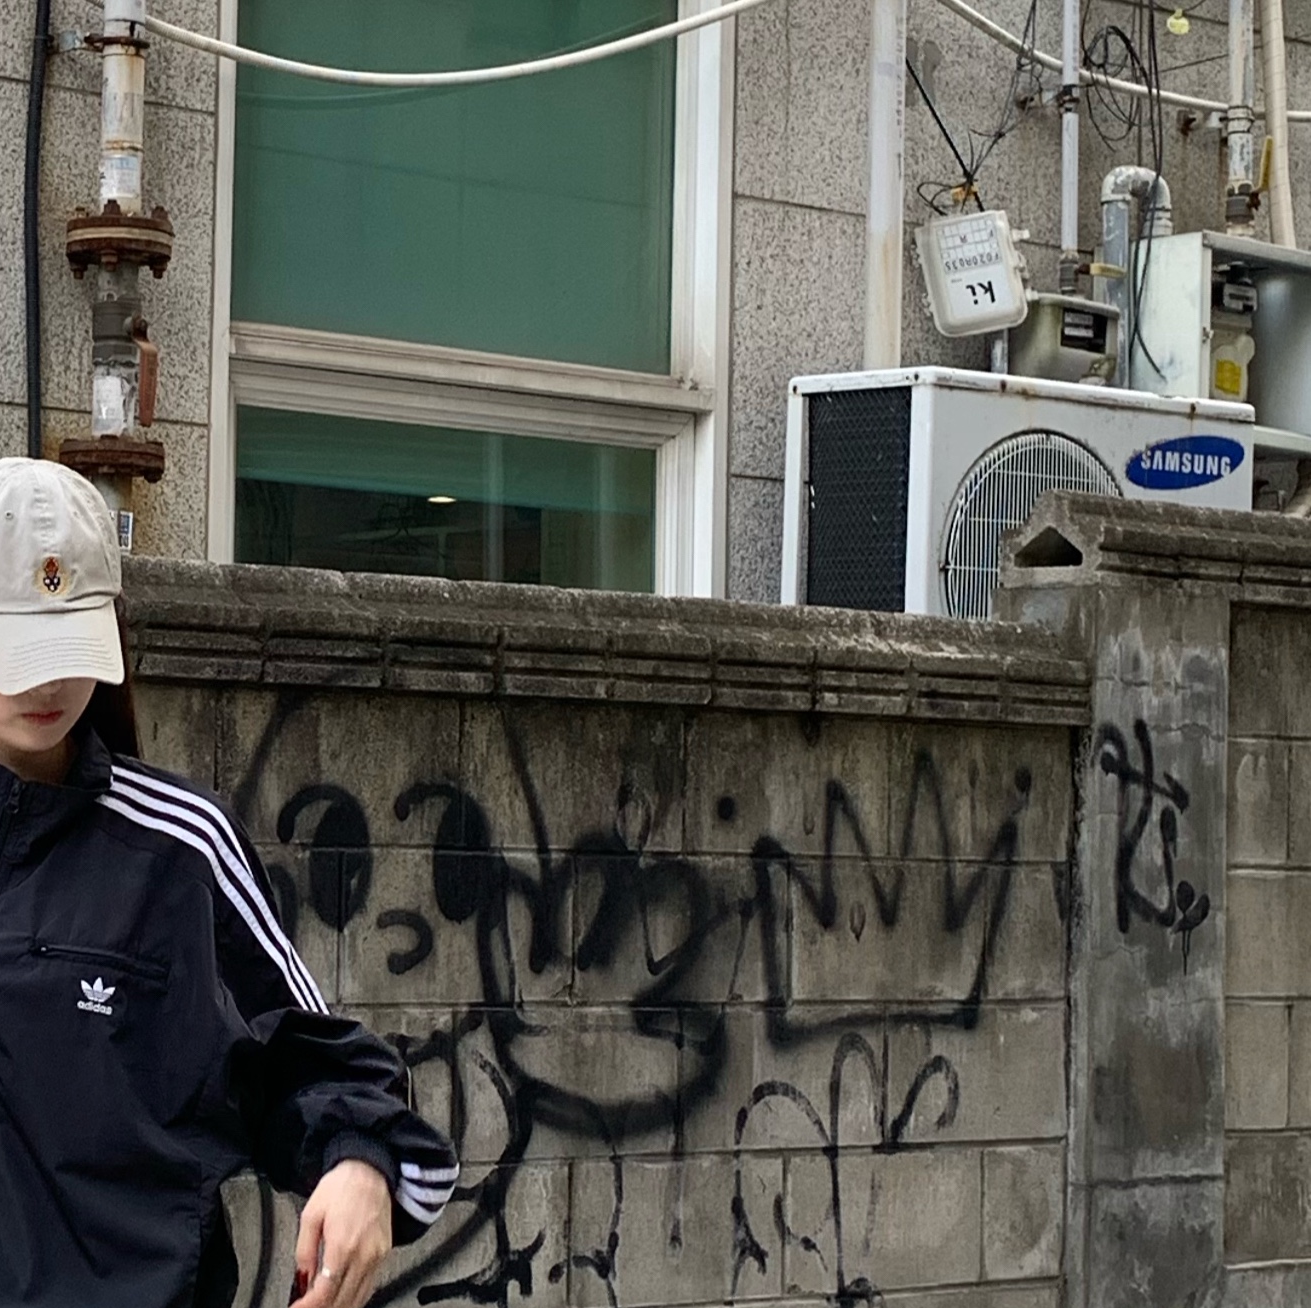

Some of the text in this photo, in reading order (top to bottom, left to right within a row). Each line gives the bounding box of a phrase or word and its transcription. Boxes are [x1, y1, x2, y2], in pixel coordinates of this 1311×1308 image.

[965, 280, 996, 305] ki
[1140, 450, 1232, 476] SAMSUNG
[77, 1000, 113, 1016] adidas
